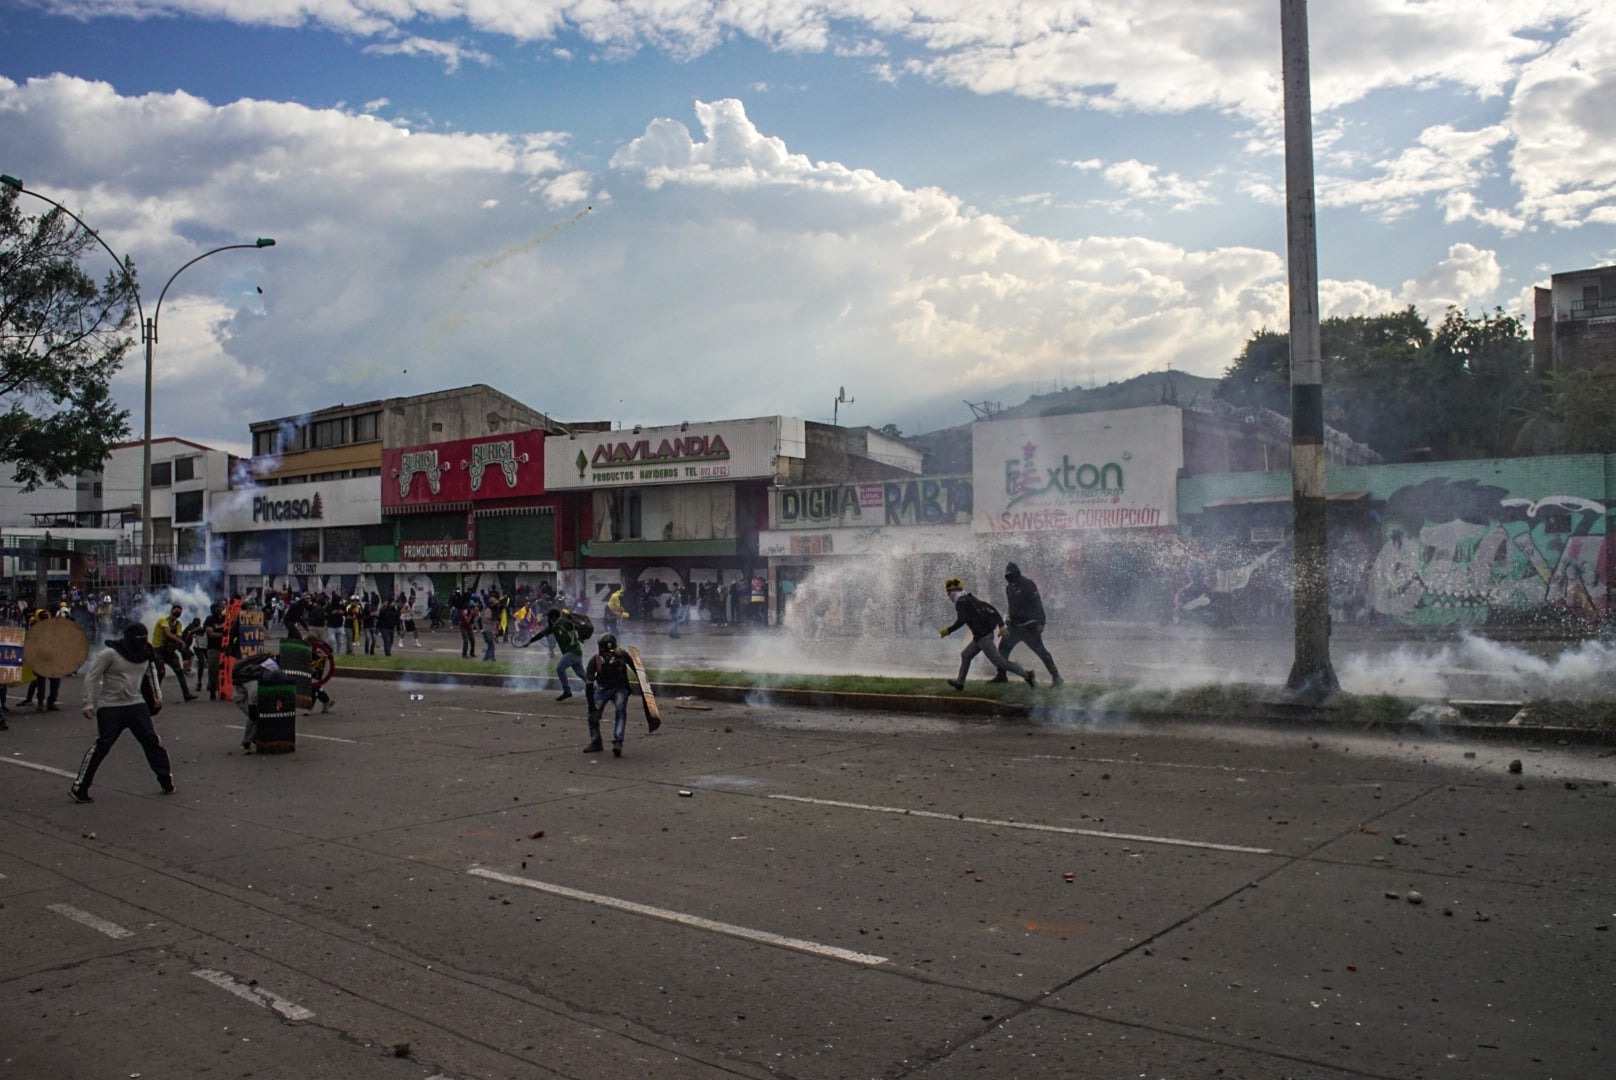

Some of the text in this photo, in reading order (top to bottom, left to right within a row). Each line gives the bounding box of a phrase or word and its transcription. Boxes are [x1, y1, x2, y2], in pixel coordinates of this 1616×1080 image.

[592, 434, 729, 463] NAVILANDIA
[592, 471, 634, 483] PRODUCTOS
[685, 466, 698, 477] TEL
[253, 496, 310, 522] Pincaso
[403, 544, 448, 557] PROMOCIONES
